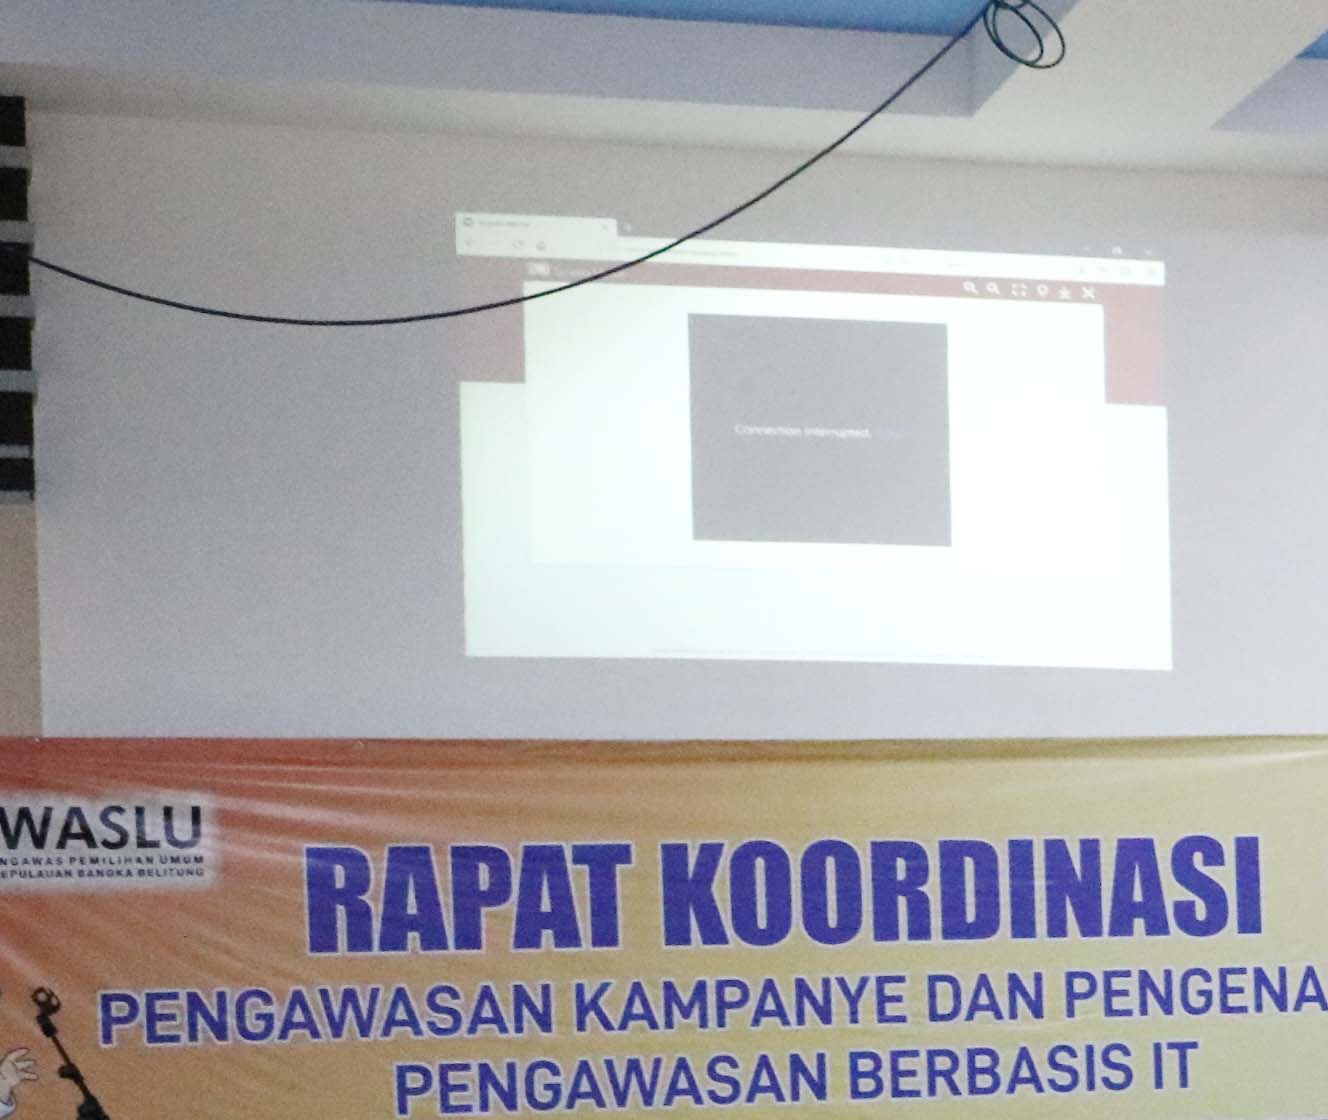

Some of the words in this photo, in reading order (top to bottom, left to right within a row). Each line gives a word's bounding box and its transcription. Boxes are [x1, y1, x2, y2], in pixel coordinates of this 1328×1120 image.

[69, 856, 154, 865] PEMILIHAN
[160, 855, 204, 865] UMUM
[78, 868, 132, 878] BANGKA
[138, 867, 204, 877] BELITUNG
[305, 843, 632, 954] RAPAT
[660, 835, 1262, 946] KOORDINASI
[101, 983, 553, 1045] PENGAWASAN
[575, 975, 907, 1033] KAMPANYE
[928, 971, 1044, 1023] DAN
[397, 1053, 827, 1116] PENGAWASAN
[849, 1043, 1132, 1101] BERBASIS
[1153, 1041, 1198, 1090] IT
